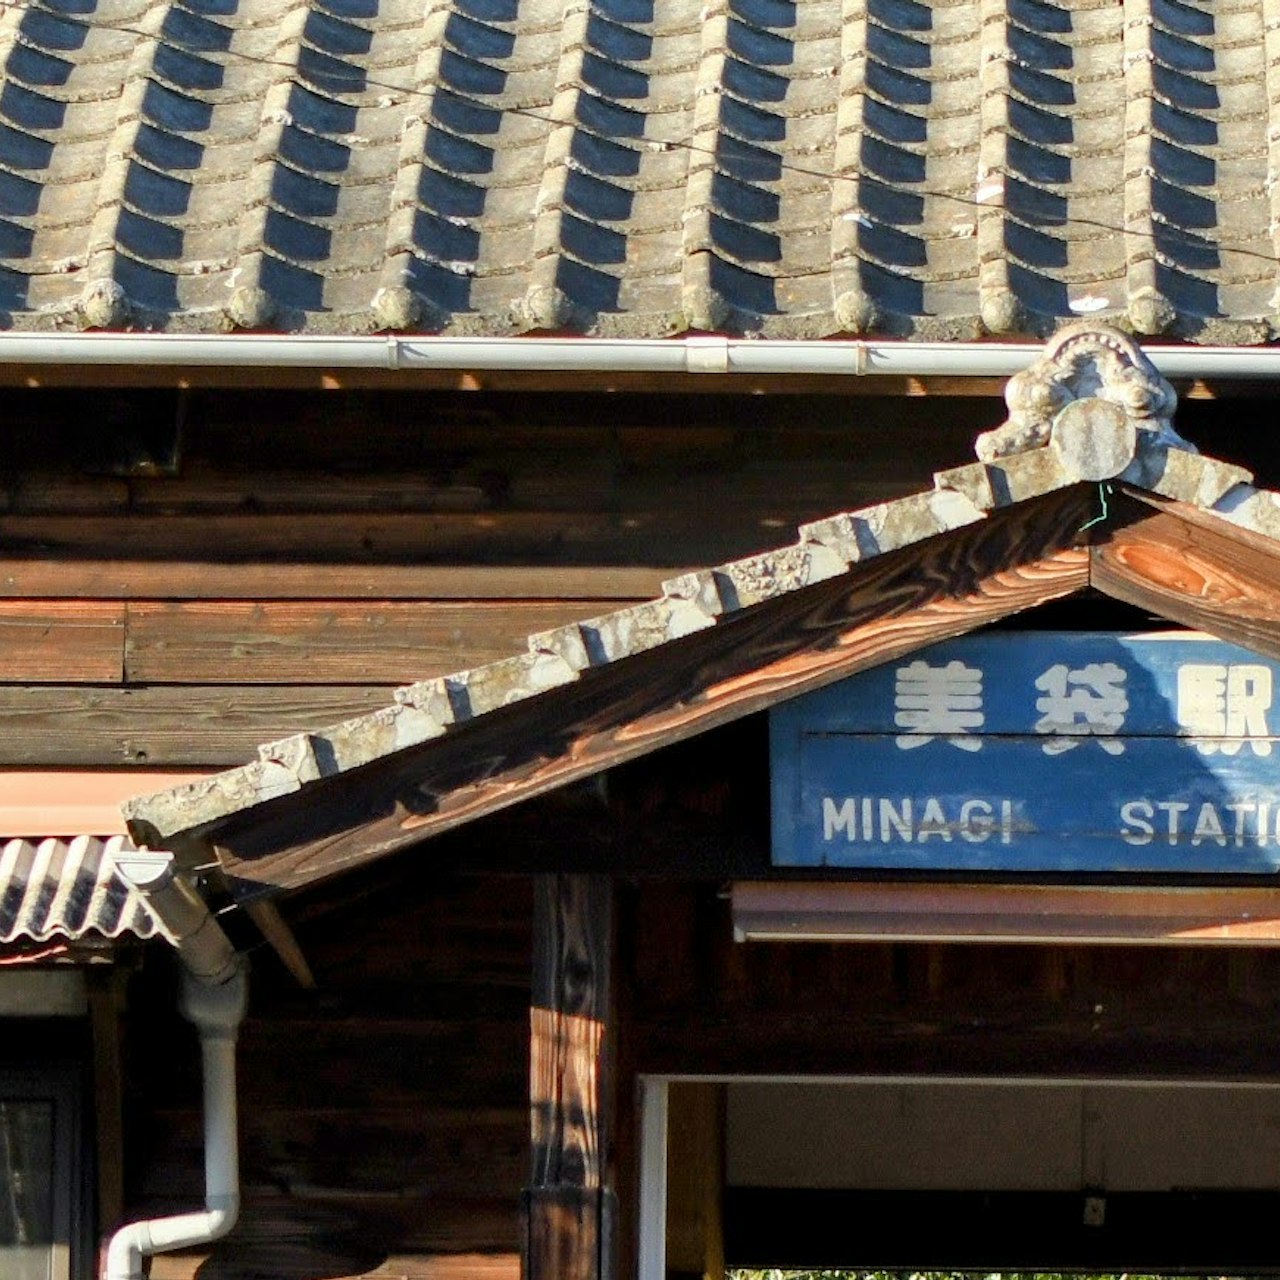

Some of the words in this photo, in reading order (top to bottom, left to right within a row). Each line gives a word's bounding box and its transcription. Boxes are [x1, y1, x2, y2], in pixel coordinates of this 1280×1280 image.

[895, 660, 1273, 757] 美袋駅
[823, 797, 1013, 844] MINAGI
